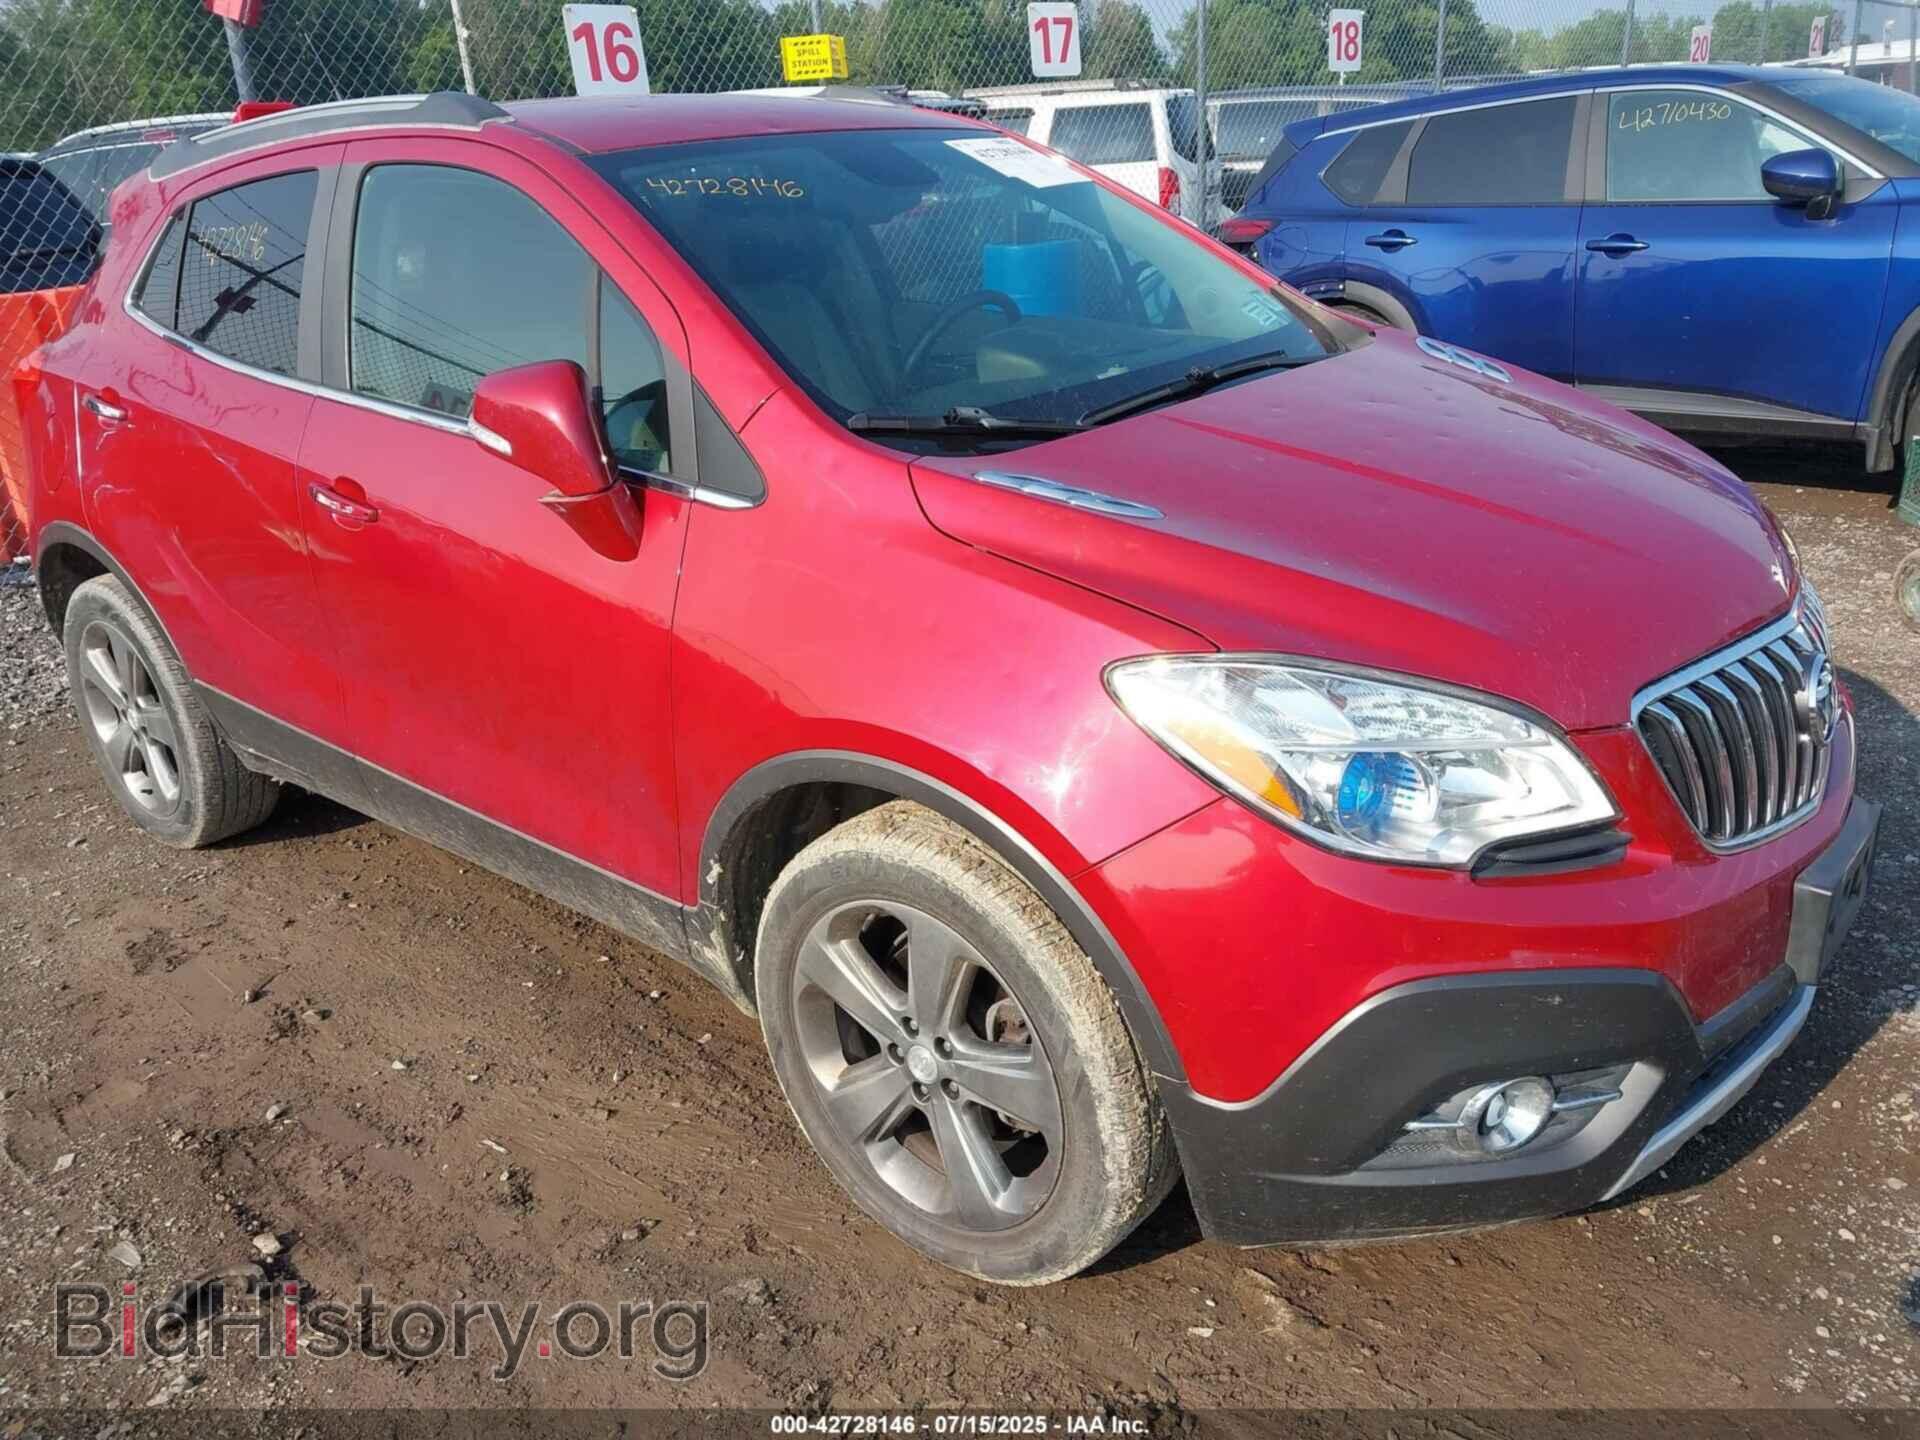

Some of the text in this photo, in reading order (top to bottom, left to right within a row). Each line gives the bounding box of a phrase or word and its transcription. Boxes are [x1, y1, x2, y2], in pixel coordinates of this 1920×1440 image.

[572, 22, 640, 83] 16
[796, 48, 821, 57] SPILL
[1033, 16, 1074, 64] 17
[1331, 20, 1360, 62] 18
[1691, 35, 1709, 62] 20
[792, 59, 829, 68] STATION
[1619, 102, 1733, 133] 42710430
[646, 178, 804, 197] 42728146
